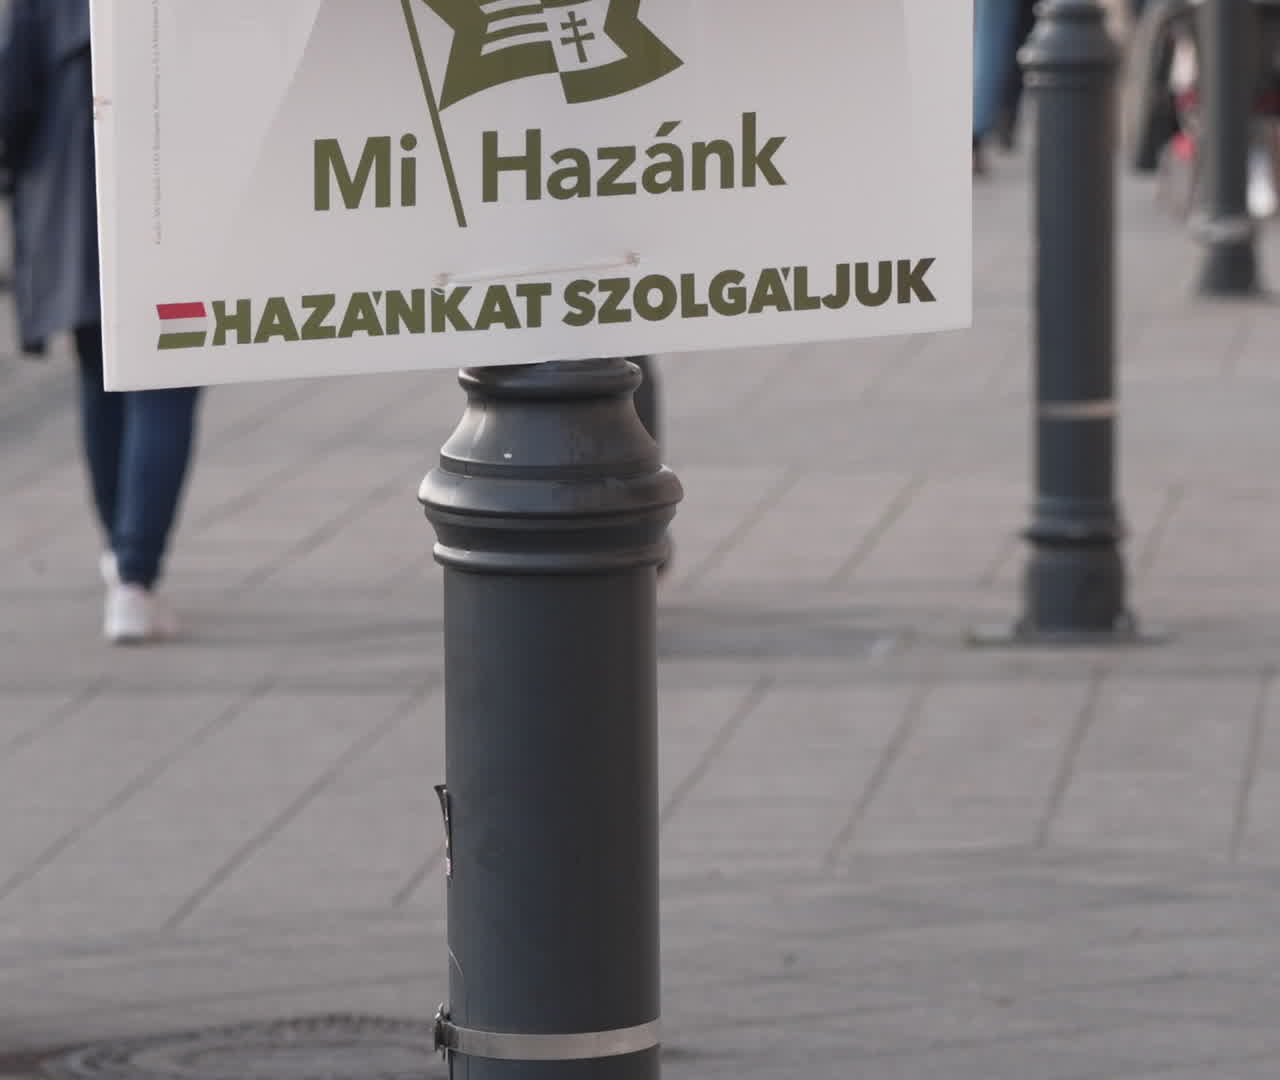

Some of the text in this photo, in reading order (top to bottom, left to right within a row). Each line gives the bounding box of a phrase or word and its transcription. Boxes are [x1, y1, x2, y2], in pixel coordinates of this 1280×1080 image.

[313, 111, 788, 211] Mi Hazánk
[212, 257, 936, 346] HAZÁNKAT SZOLGÁLJUK
